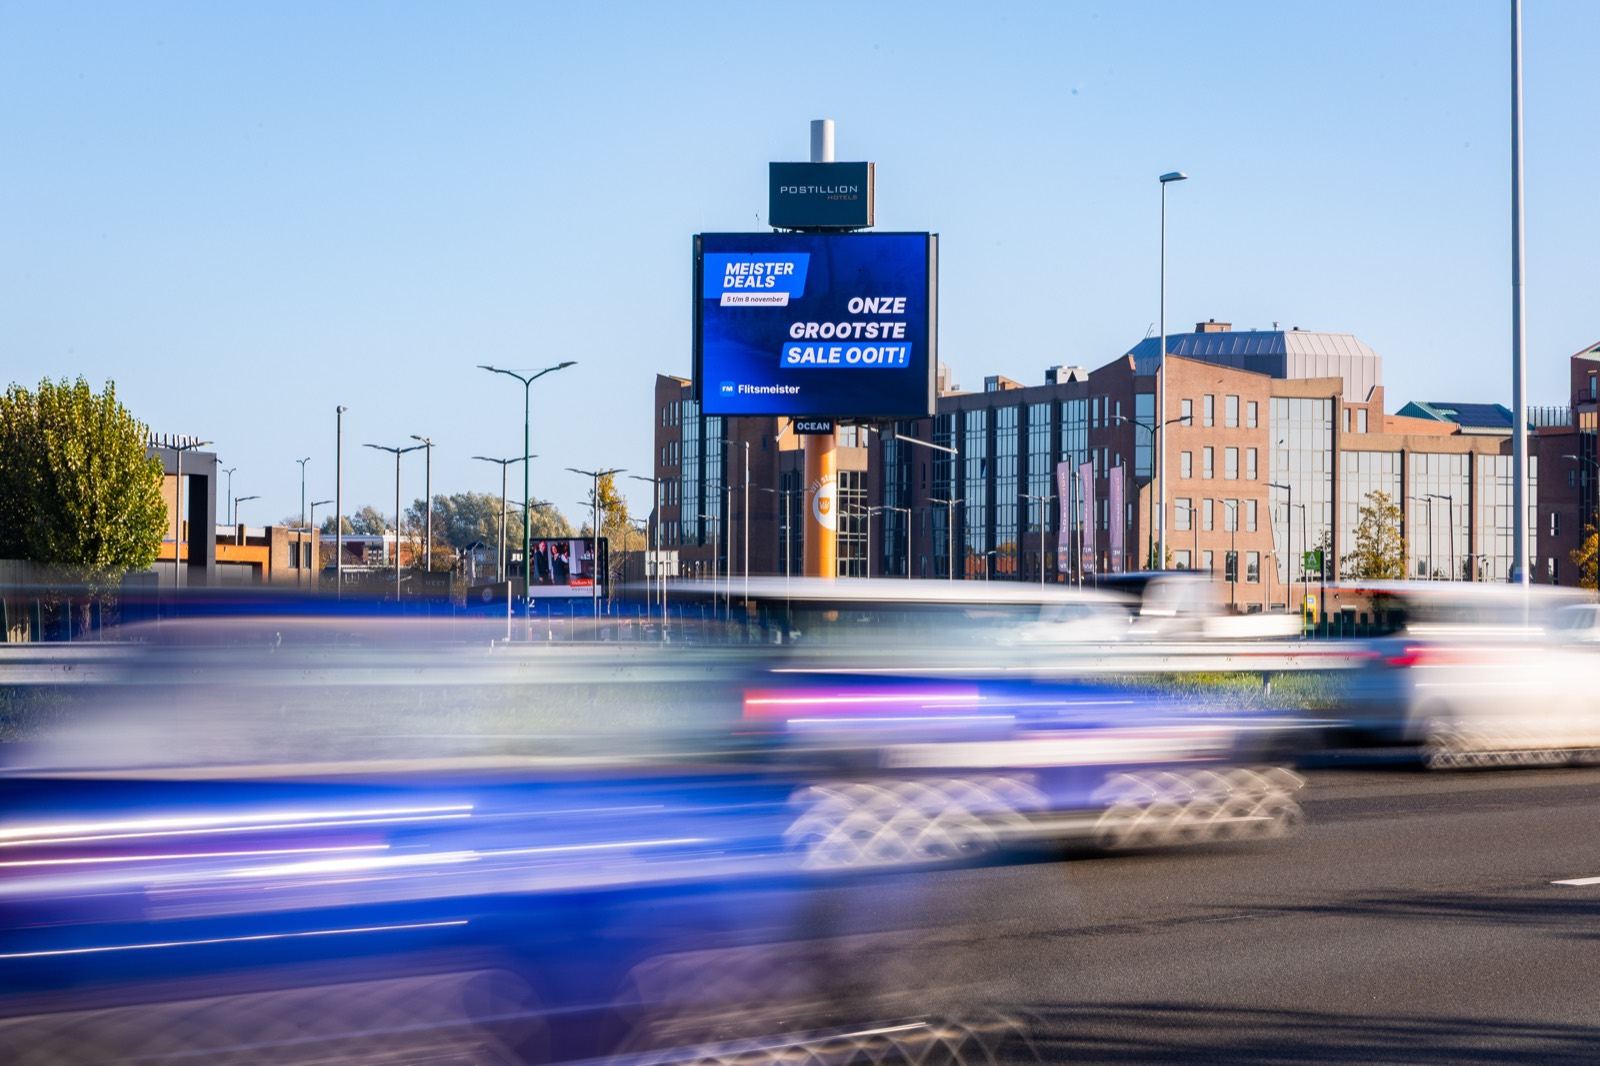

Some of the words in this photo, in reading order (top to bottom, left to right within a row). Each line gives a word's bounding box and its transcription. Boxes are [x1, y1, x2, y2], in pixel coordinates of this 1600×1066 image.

[780, 185, 858, 194] POSTILLION
[725, 262, 794, 275] MEISTER
[723, 275, 776, 288] DEALS
[847, 297, 907, 314] ONZE
[789, 322, 907, 339] GROOTSTE
[787, 346, 842, 364] SALE
[845, 346, 906, 364] OOIT!
[738, 384, 800, 394] Flitsmeister
[797, 421, 830, 431] OCEAN
